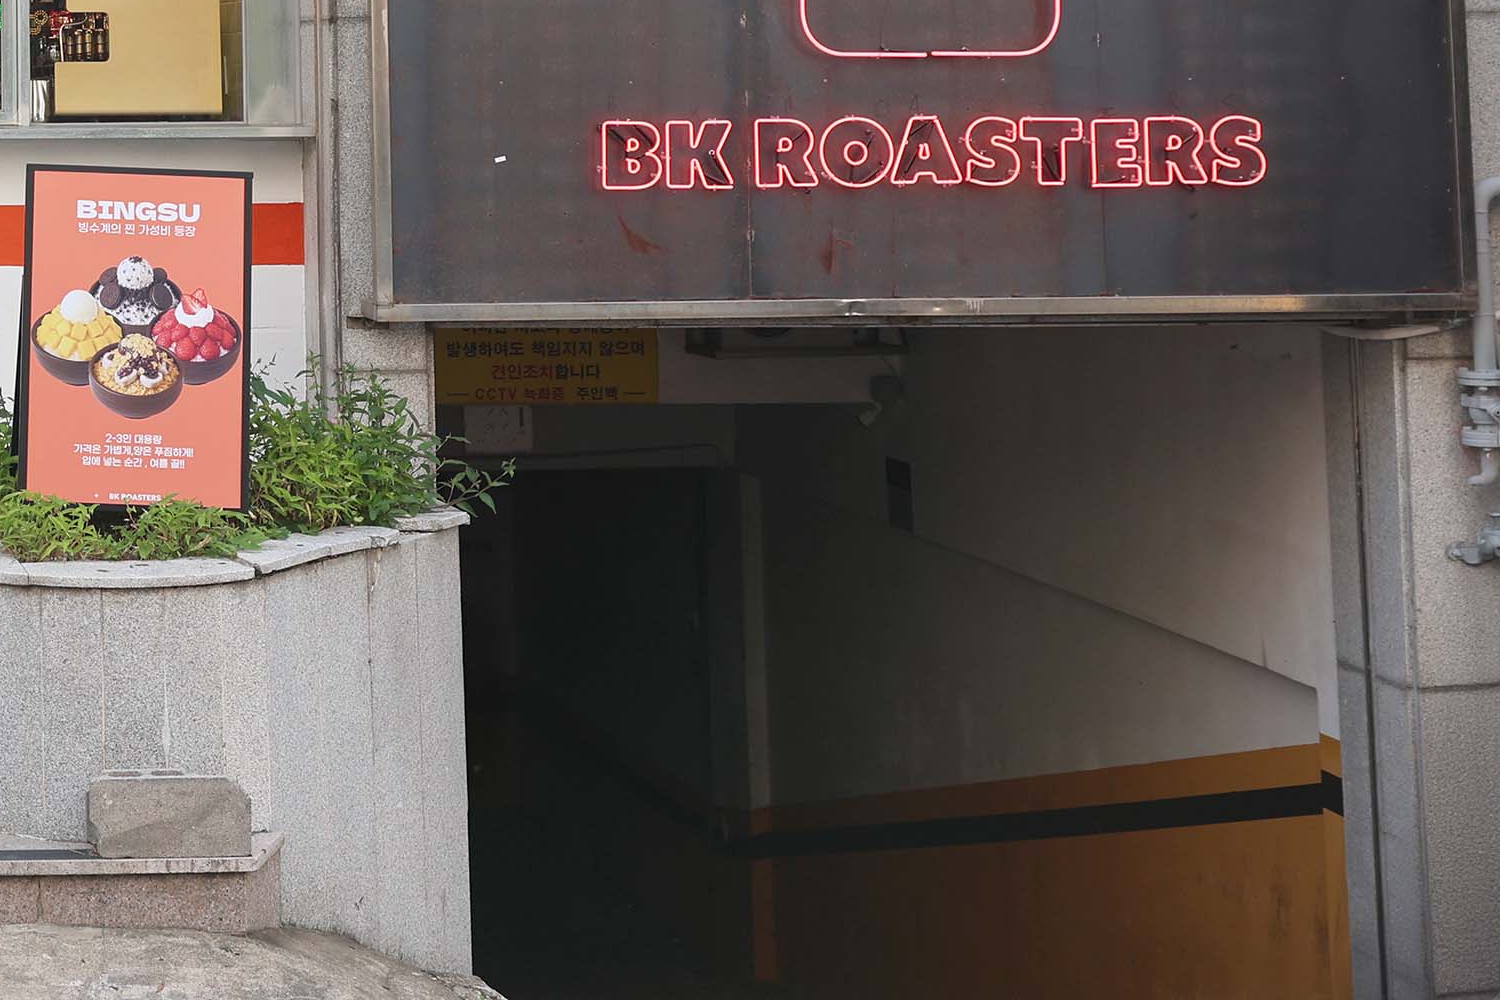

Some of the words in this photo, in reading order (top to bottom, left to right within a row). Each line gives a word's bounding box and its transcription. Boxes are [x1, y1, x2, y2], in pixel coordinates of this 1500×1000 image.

[601, 119, 734, 190] BK
[753, 115, 1267, 189] ROASTERS
[76, 199, 201, 223] BINGSU
[78, 222, 122, 234] 빙수계의
[124, 223, 135, 235] 찐
[138, 224, 171, 237] 가성비
[174, 225, 196, 237] 등장
[446, 341, 524, 358] 발생하여도
[531, 340, 592, 357] 책임지지
[599, 339, 645, 357] 않으며
[491, 363, 601, 381] 견인조치합니다
[475, 387, 517, 401] CCTV
[523, 386, 565, 401] 녹화중
[105, 433, 132, 444] 2-3인
[134, 433, 162, 445] 대용량
[73, 443, 101, 455] 가격은
[82, 455, 101, 466] 입에
[103, 456, 122, 467] 넣는
[124, 456, 142, 468] 순간
[149, 458, 168, 469] 여름
[108, 492, 120, 501] BK
[121, 493, 162, 502] ROASTERS
